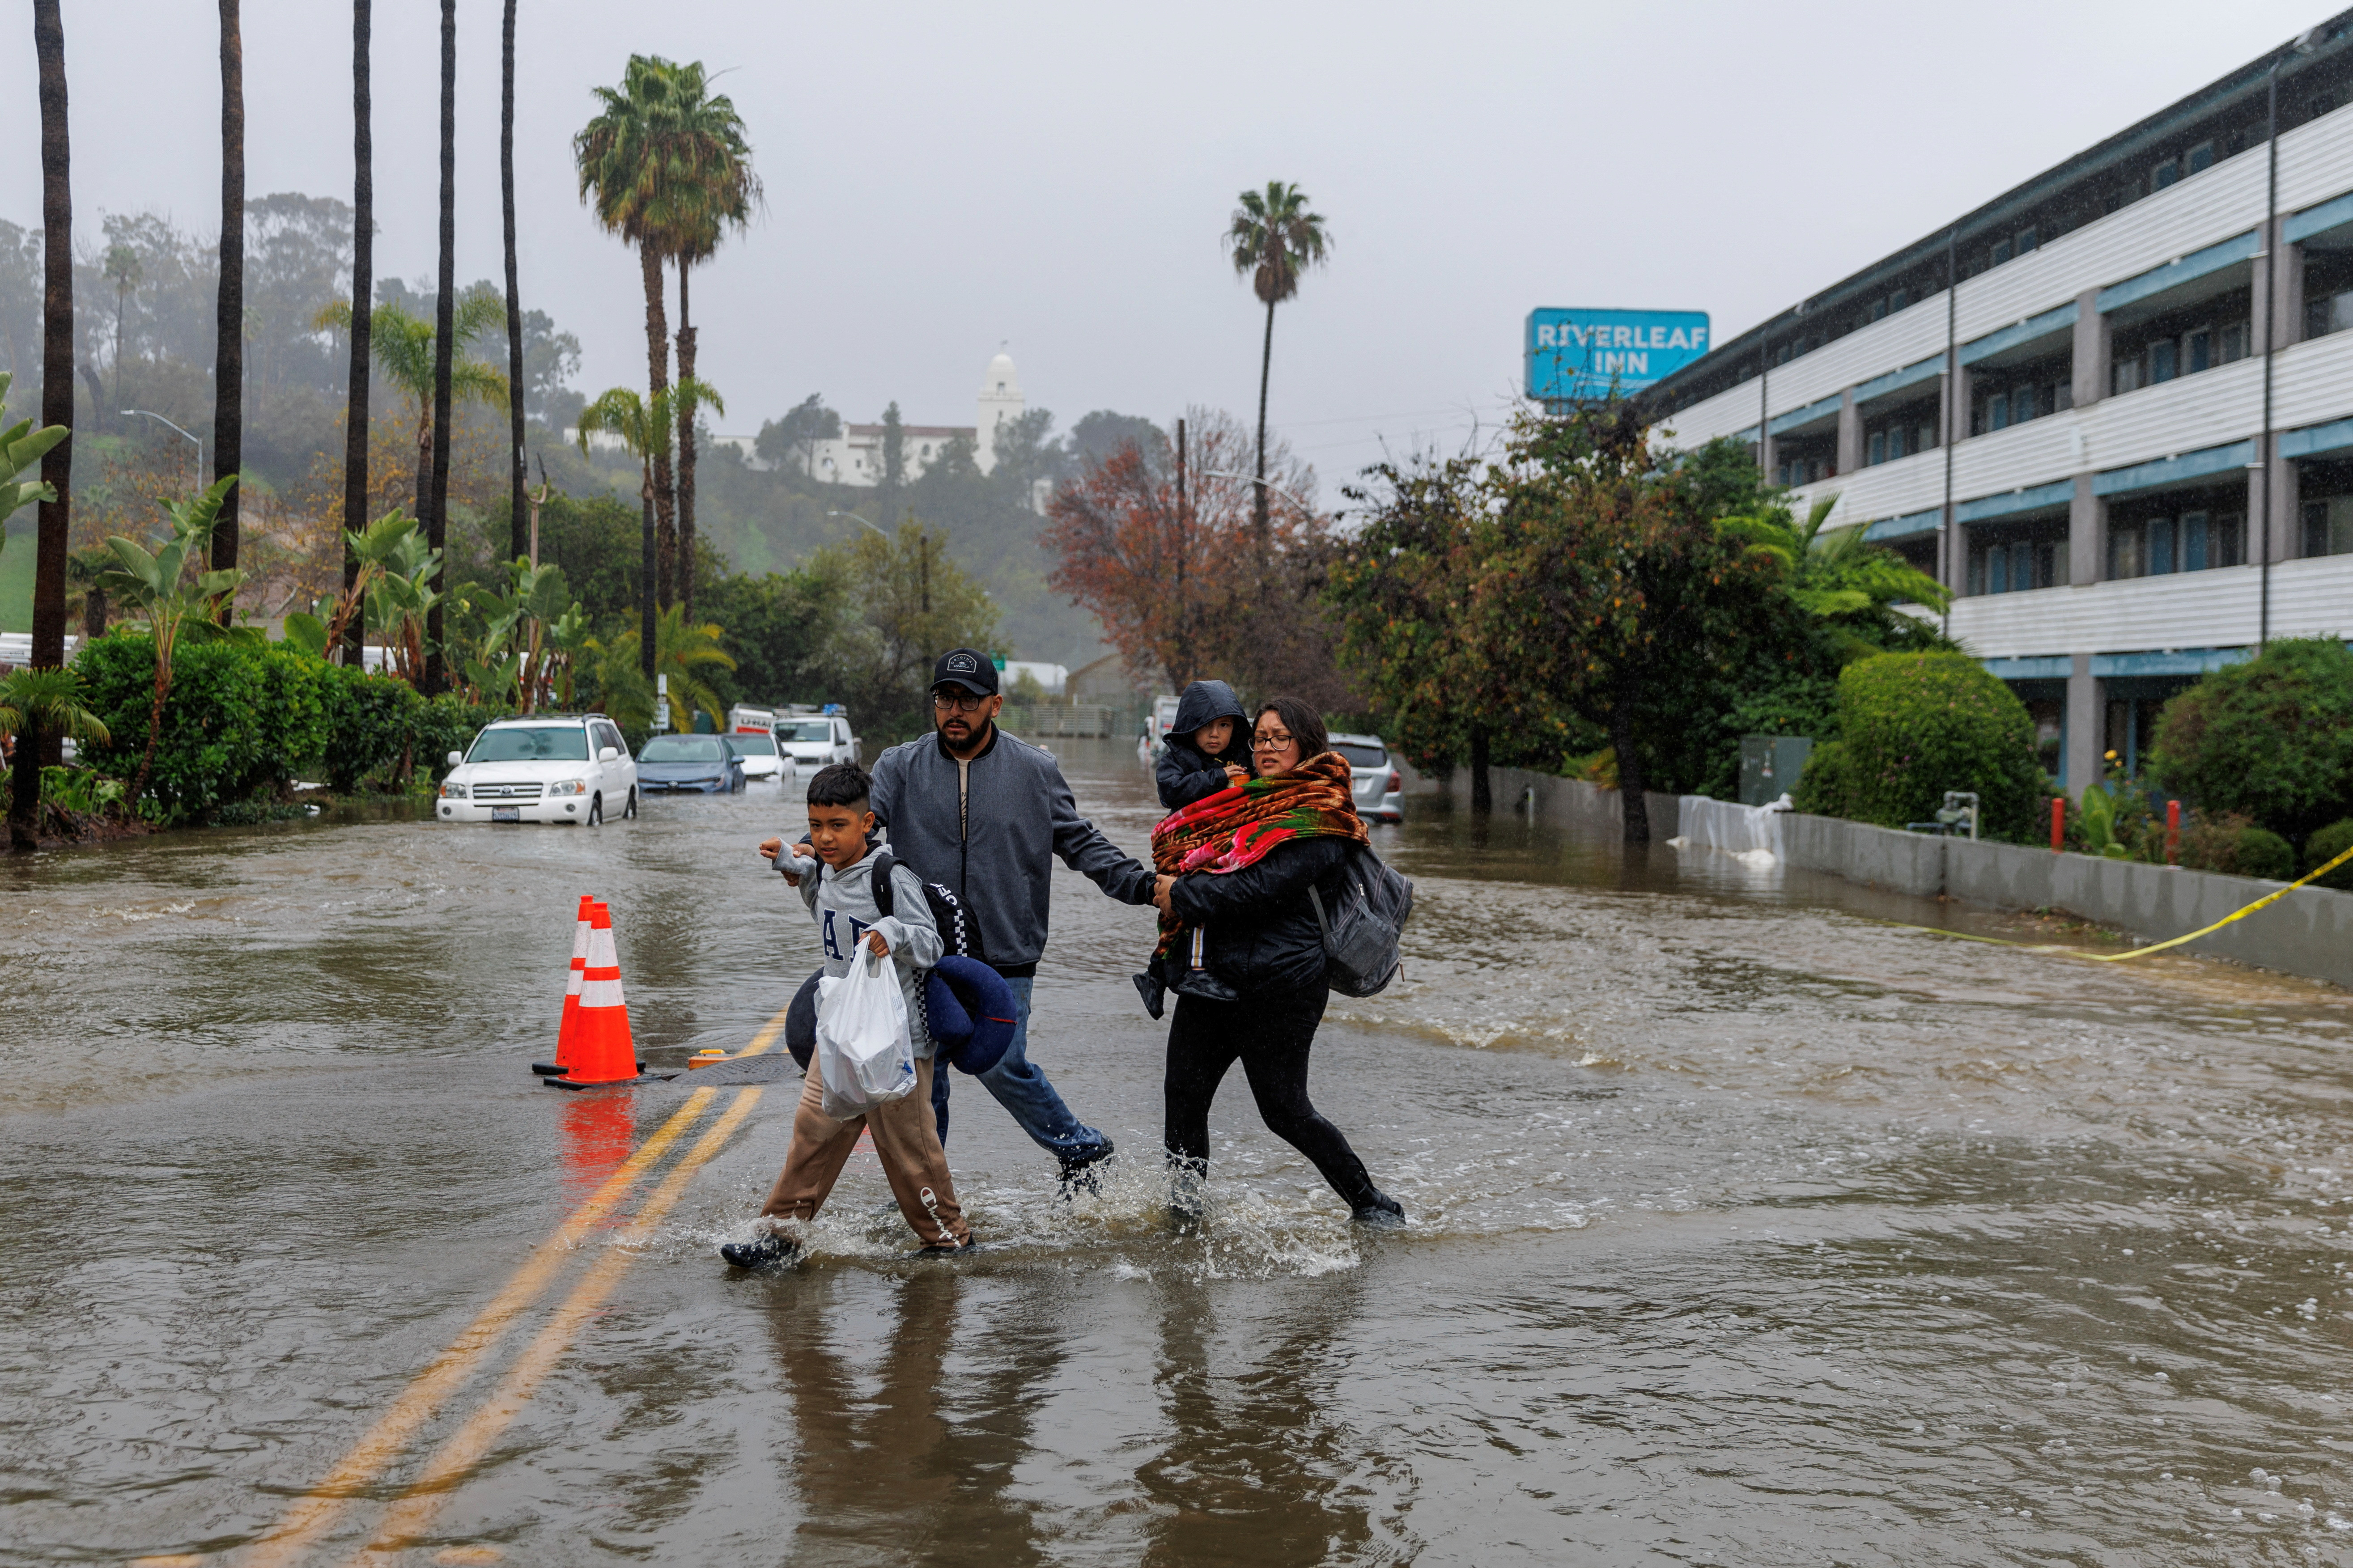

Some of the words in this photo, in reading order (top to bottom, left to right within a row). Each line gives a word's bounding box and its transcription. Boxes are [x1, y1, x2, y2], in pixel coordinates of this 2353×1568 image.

[1537, 324, 1706, 350] RIVERLEAF
[1594, 351, 1648, 374] INN
[951, 656, 974, 666] ORIGINAL
